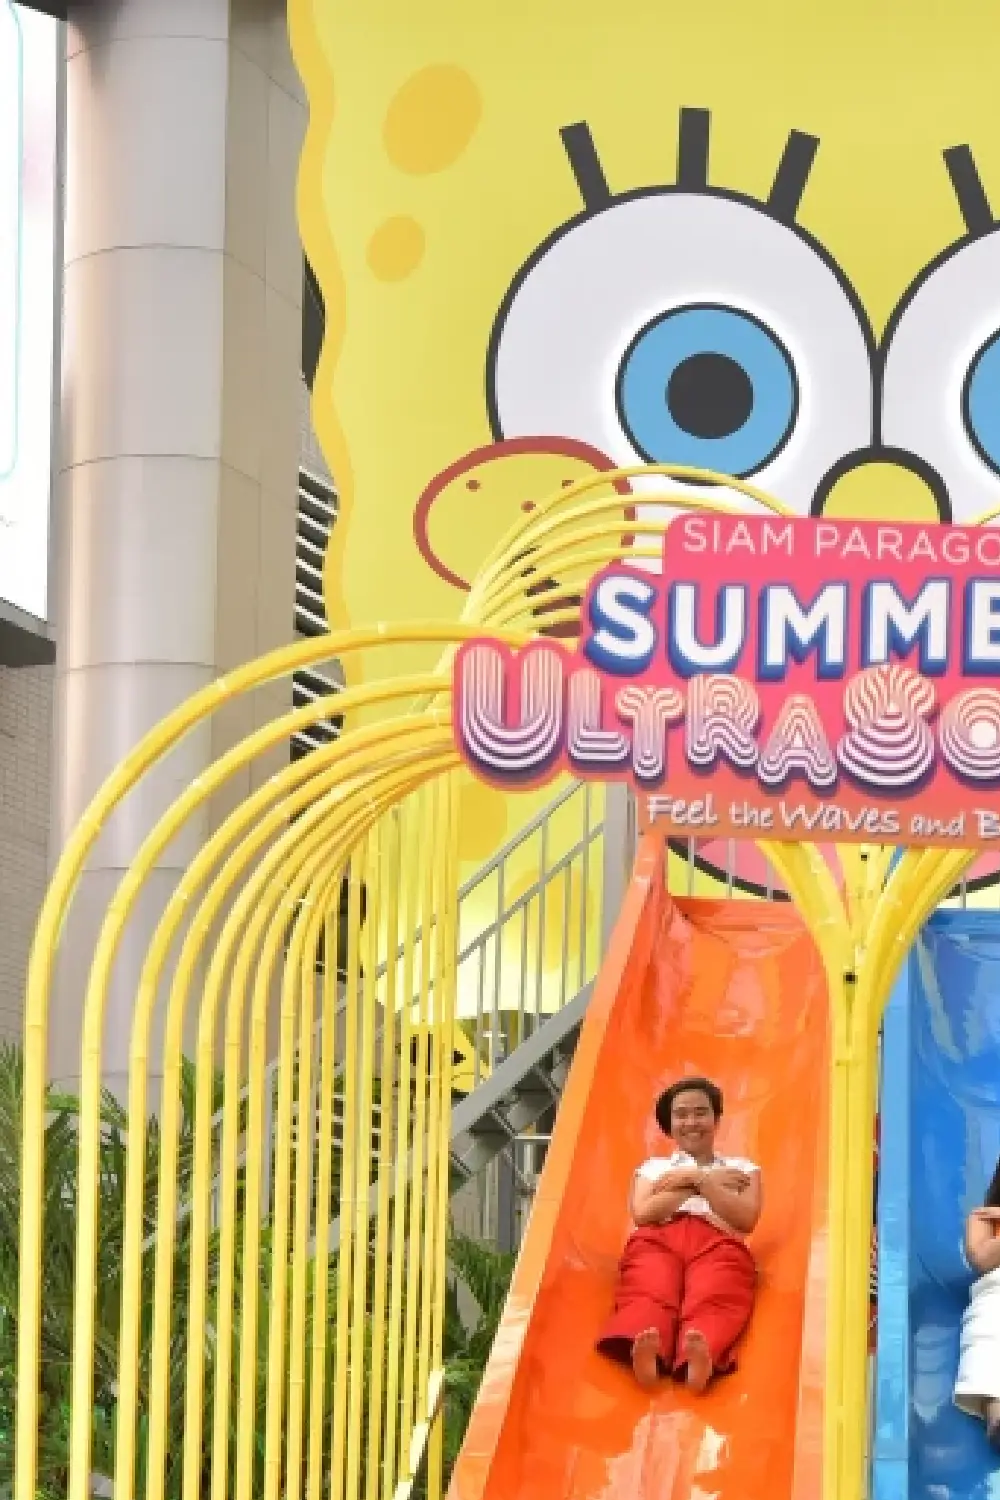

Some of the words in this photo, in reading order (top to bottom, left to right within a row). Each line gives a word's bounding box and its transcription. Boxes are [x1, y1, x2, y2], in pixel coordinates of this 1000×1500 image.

[682, 517, 795, 556] SIAM
[646, 794, 718, 826] Feel
[728, 801, 775, 830] the
[780, 800, 901, 834] Waves
[910, 811, 967, 838] and
